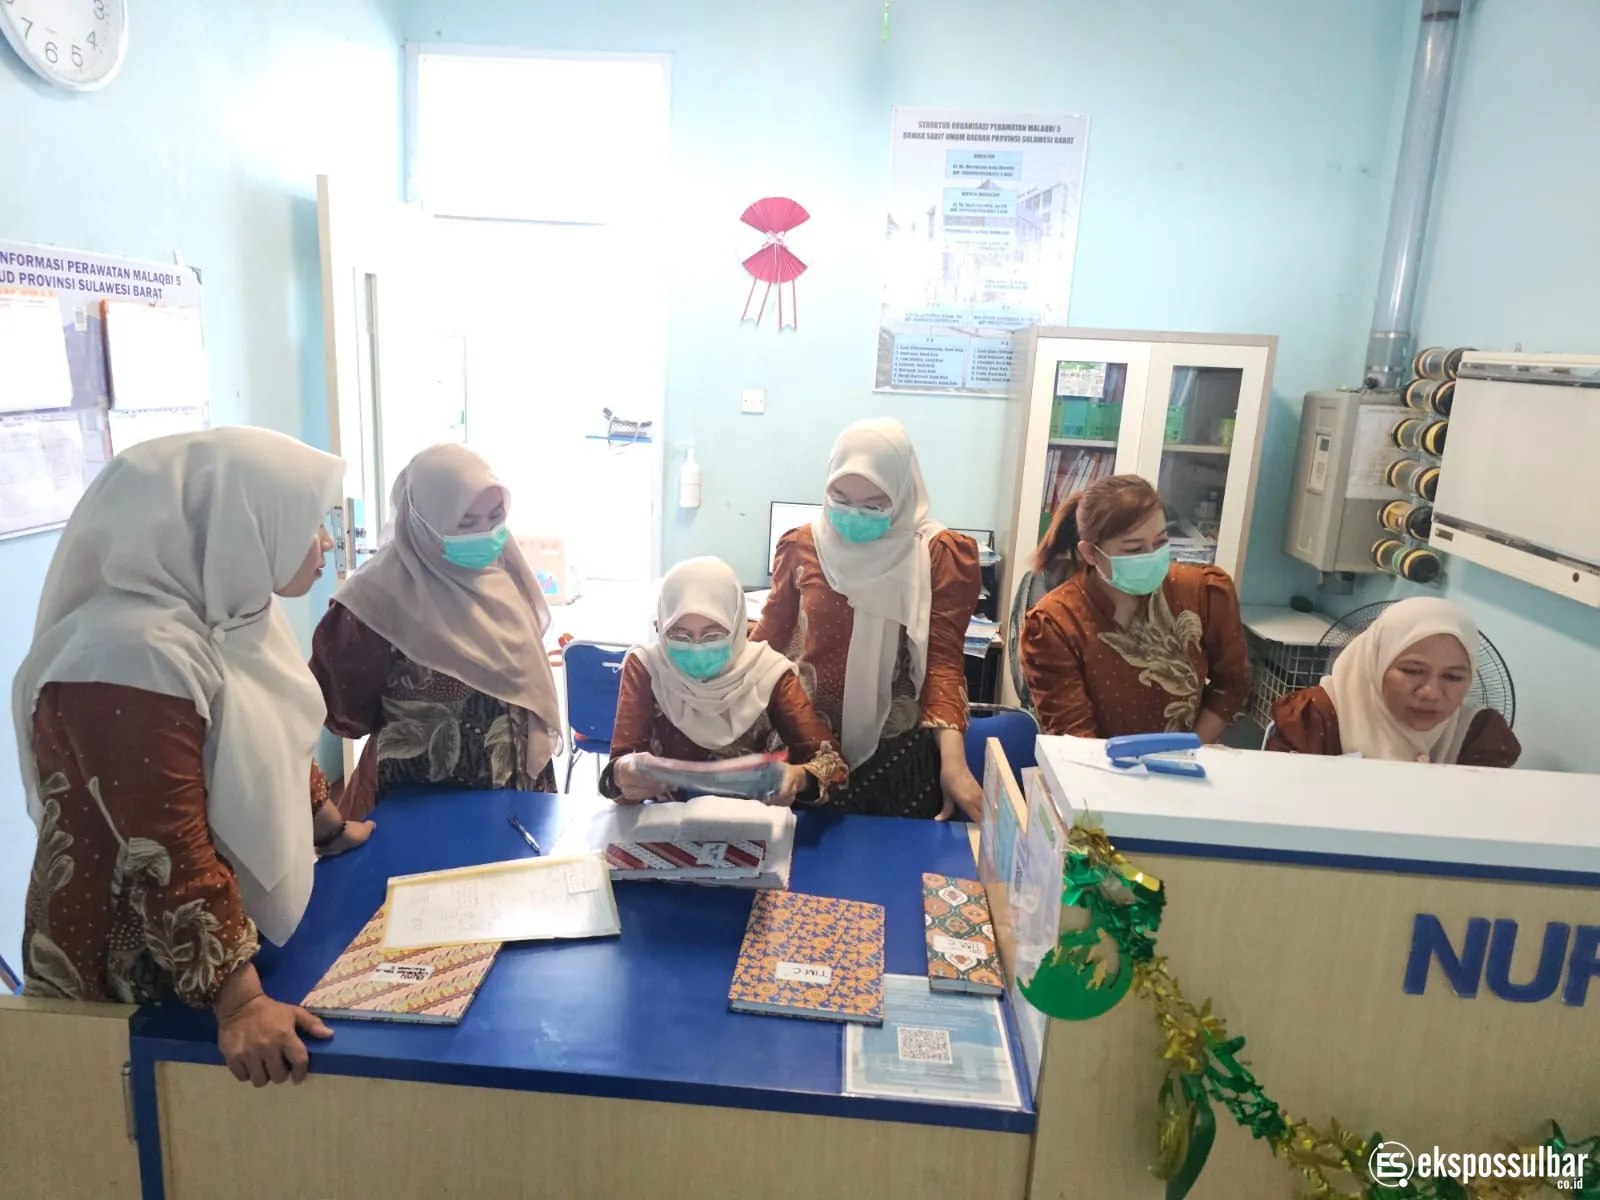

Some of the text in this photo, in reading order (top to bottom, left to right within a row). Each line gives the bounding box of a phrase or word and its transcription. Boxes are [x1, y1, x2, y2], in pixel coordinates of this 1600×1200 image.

[93, 0, 105, 20] 3
[20, 16, 34, 41] 7
[85, 30, 98, 51] 4
[45, 41, 59, 64] 6
[71, 44, 84, 68] 5
[951, 121, 989, 131] ORGANISASI
[989, 122, 1027, 132] PERAWATAN
[926, 132, 945, 141] SAKIT
[991, 134, 1021, 144] PROVINSI
[1021, 135, 1053, 145] SULAWESI
[67, 259, 131, 281] PERAWATAN
[133, 270, 174, 286] MALAQBI
[176, 276, 182, 287] 5
[19, 272, 76, 291] PROVINSI
[78, 280, 131, 297] SULAWESI
[133, 286, 163, 300] BARAT
